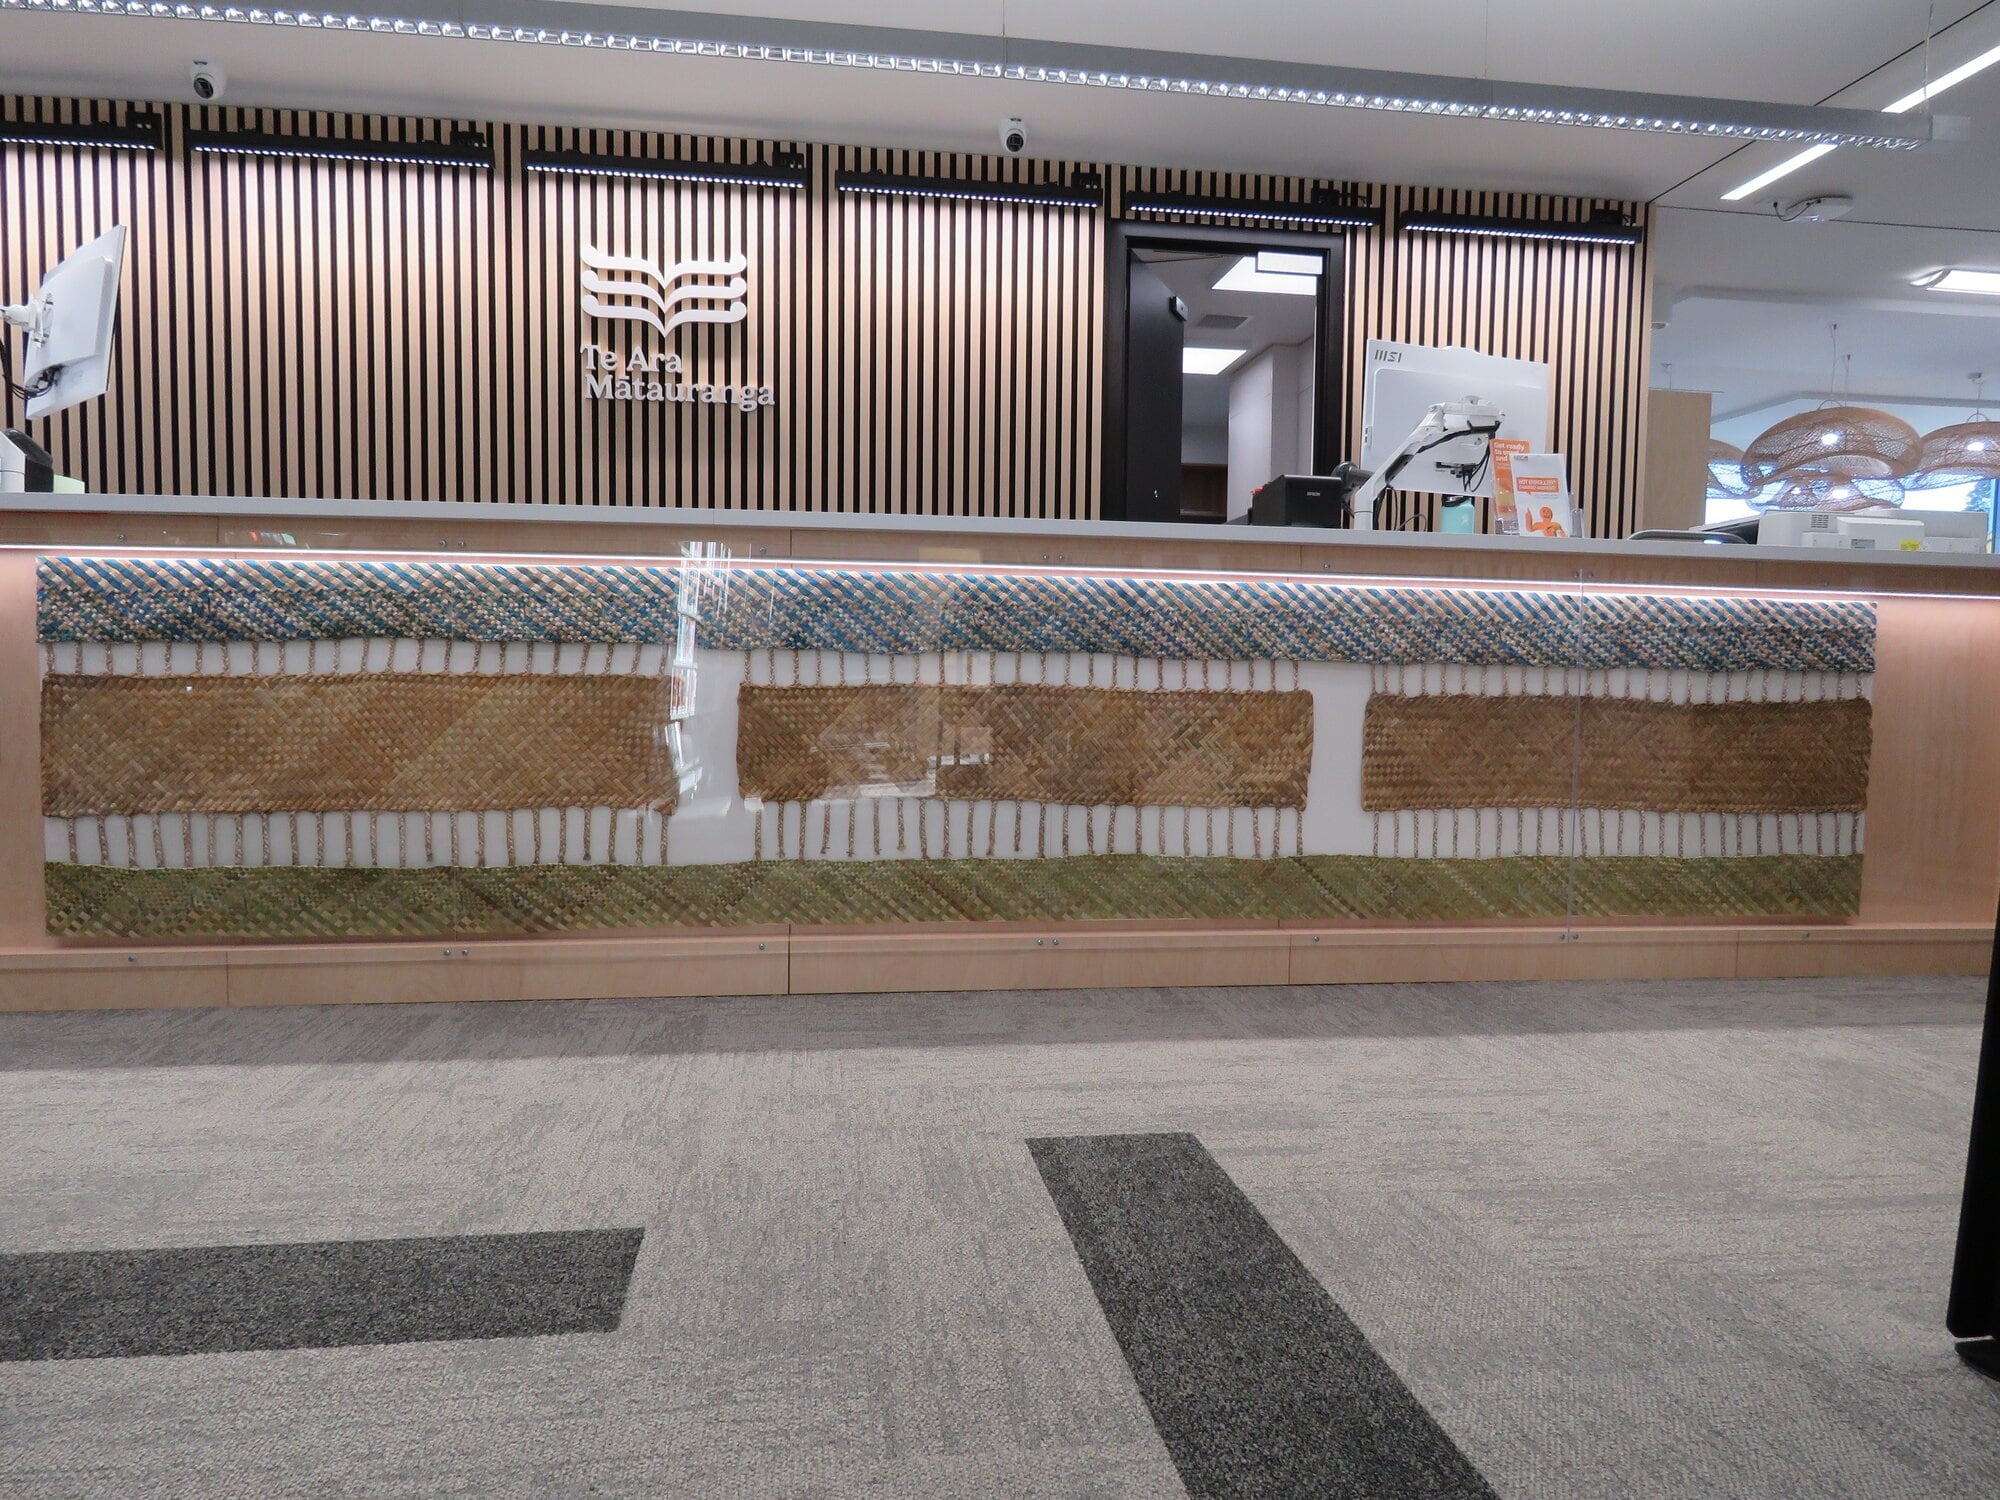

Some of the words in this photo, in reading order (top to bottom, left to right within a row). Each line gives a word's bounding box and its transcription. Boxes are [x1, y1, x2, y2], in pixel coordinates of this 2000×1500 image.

[580, 344, 617, 371] Te
[626, 346, 682, 373] Ara
[584, 373, 775, 412] Mātauranga
